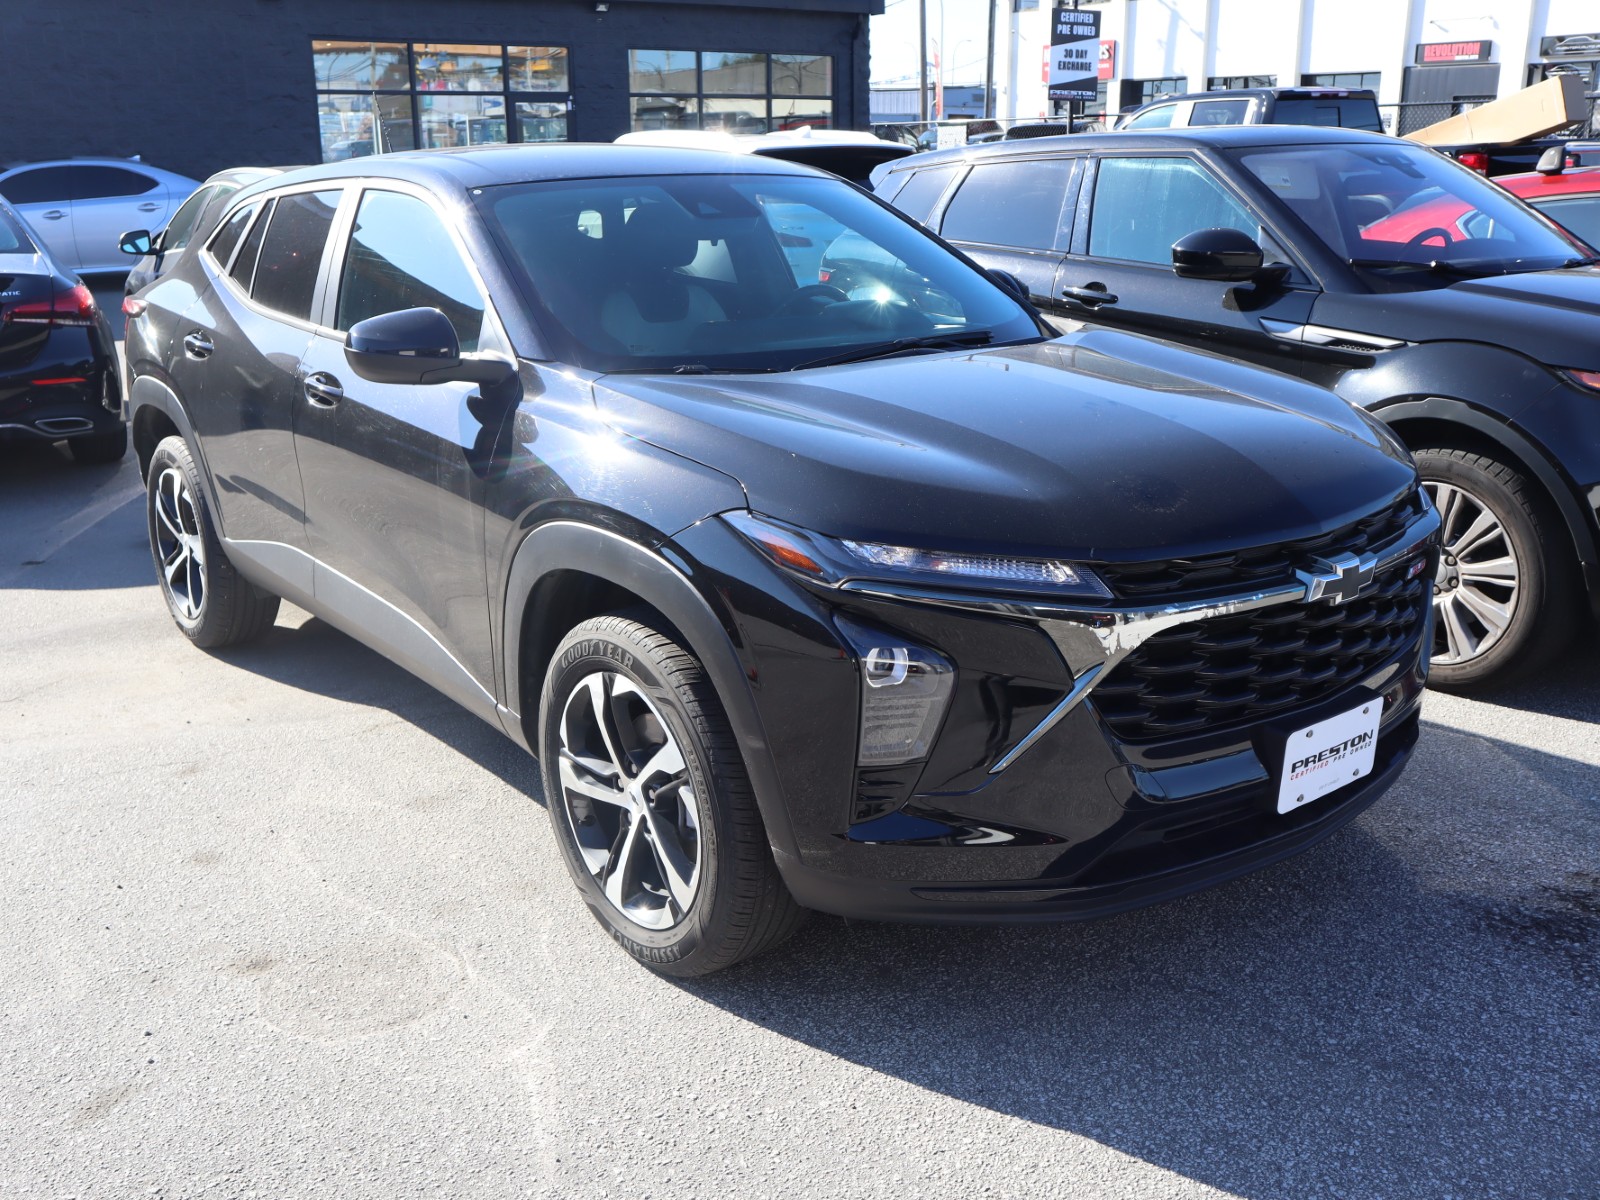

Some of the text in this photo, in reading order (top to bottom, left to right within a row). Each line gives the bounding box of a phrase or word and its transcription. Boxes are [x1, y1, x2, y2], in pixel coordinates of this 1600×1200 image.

[1061, 12, 1094, 24] CERTIFIED
[1057, 24, 1096, 36] PRE OWNED
[1064, 48, 1073, 59] 30
[1075, 49, 1088, 59] DAY
[1424, 42, 1480, 57] REVOLUTION
[1058, 60, 1092, 72] EXCHANGE
[1291, 729, 1374, 774] PRESTON
[1290, 740, 1372, 781] CERTIFIED PRE OWNED
[609, 925, 681, 963] ASSURANCE
